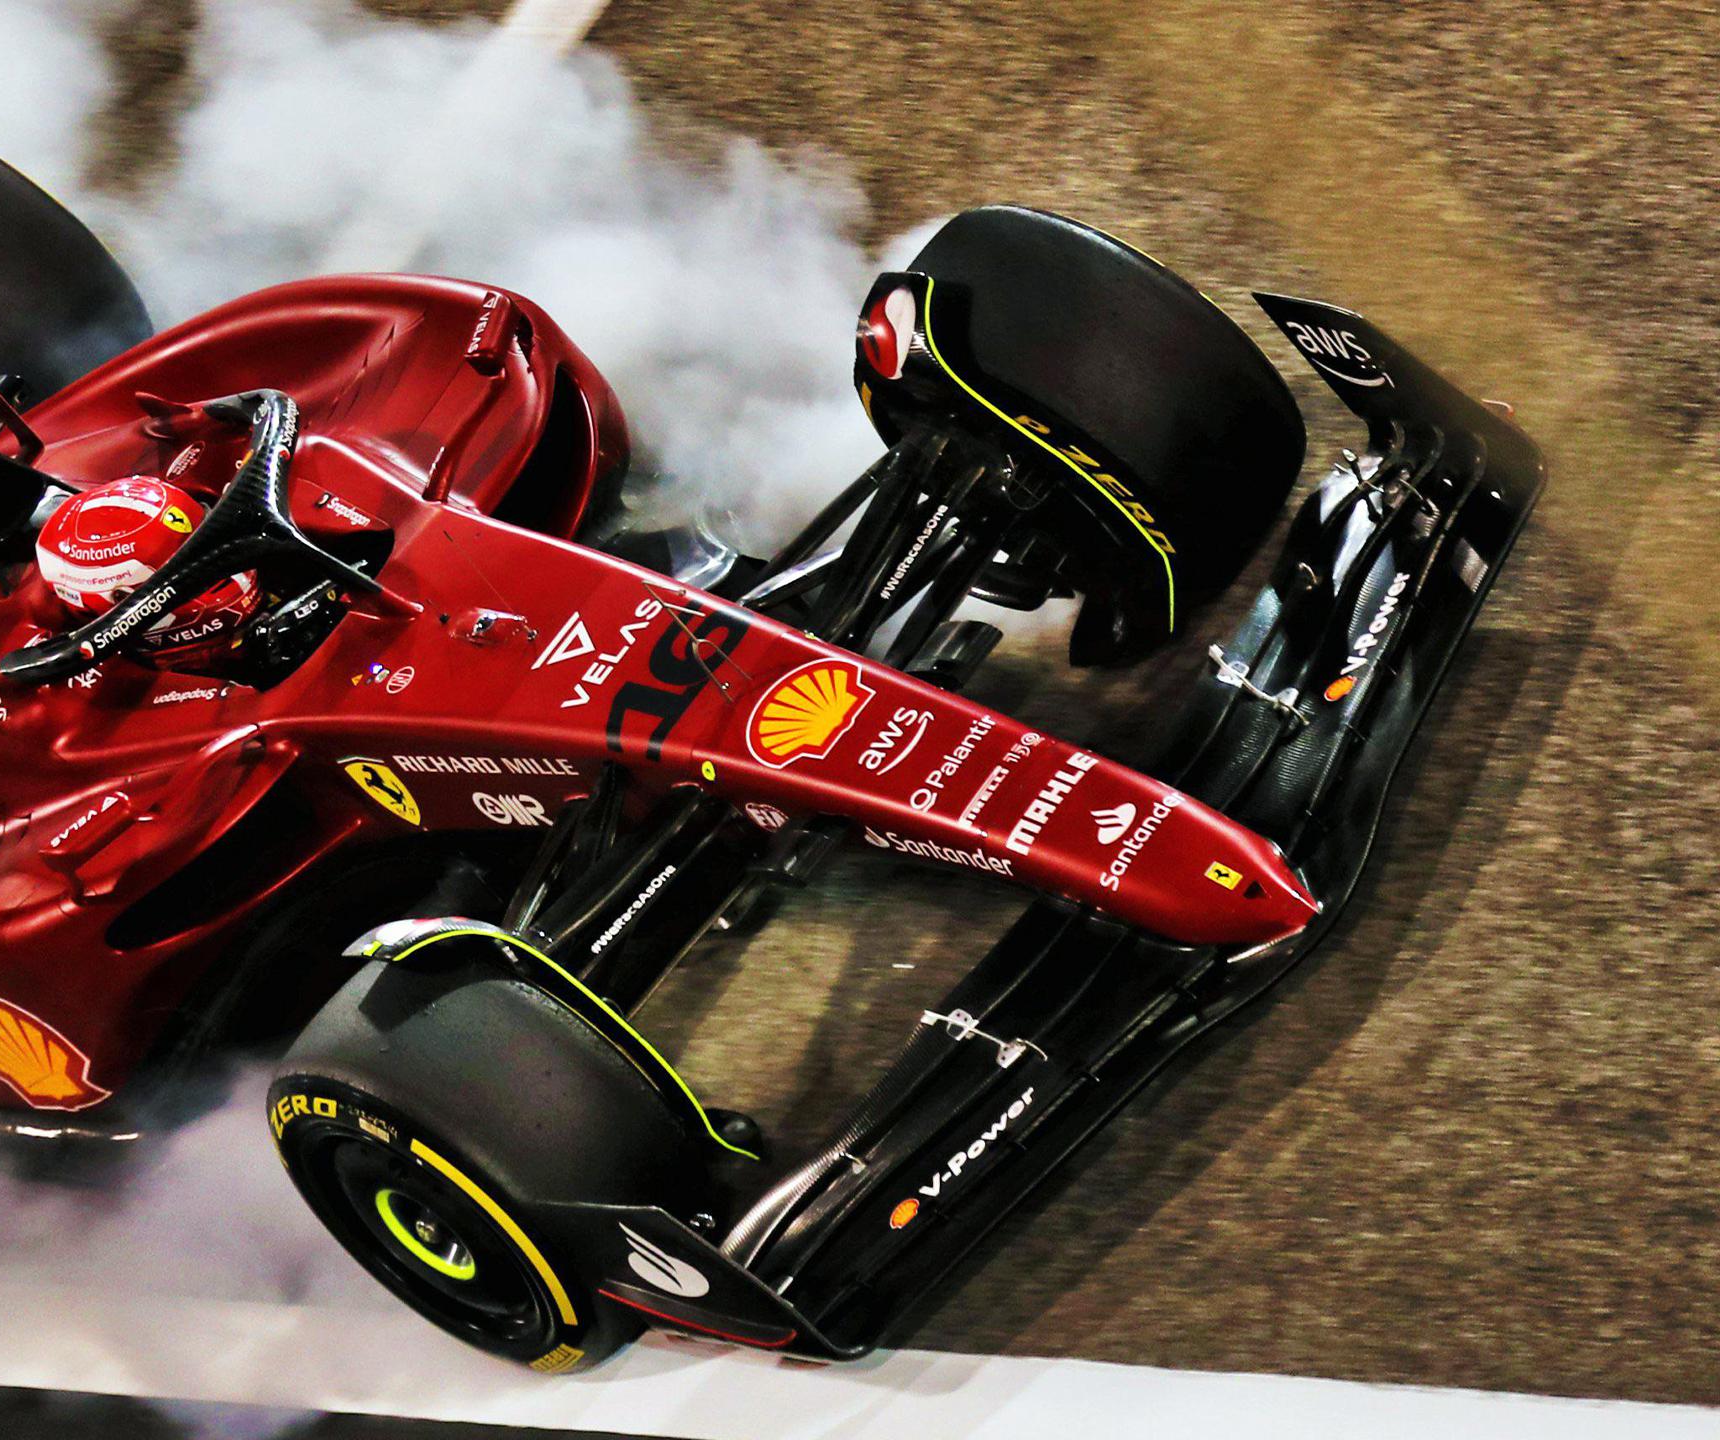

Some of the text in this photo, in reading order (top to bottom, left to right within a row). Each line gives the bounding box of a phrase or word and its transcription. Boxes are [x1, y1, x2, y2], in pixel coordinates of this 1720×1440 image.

[1286, 321, 1372, 362] aws
[69, 541, 136, 561] Santander
[879, 504, 949, 600] #WeRaceAsOne
[93, 584, 177, 650] Snapdragon
[168, 618, 224, 643] VELAS
[560, 597, 664, 709] VELAS
[1340, 572, 1411, 676] V-Power
[605, 599, 753, 762] 16
[392, 754, 580, 777] RICHARD MILLE
[858, 706, 920, 770] aws
[930, 713, 997, 792] Palantir
[958, 765, 1010, 829] PIRELLI
[1005, 750, 1100, 857] MAHLE
[889, 831, 1013, 877] Santander
[1099, 791, 1187, 892] Santander
[590, 863, 678, 954] #WeRaceAsOne
[270, 1094, 338, 1140] ZERO
[918, 1086, 1035, 1197] V-Power
